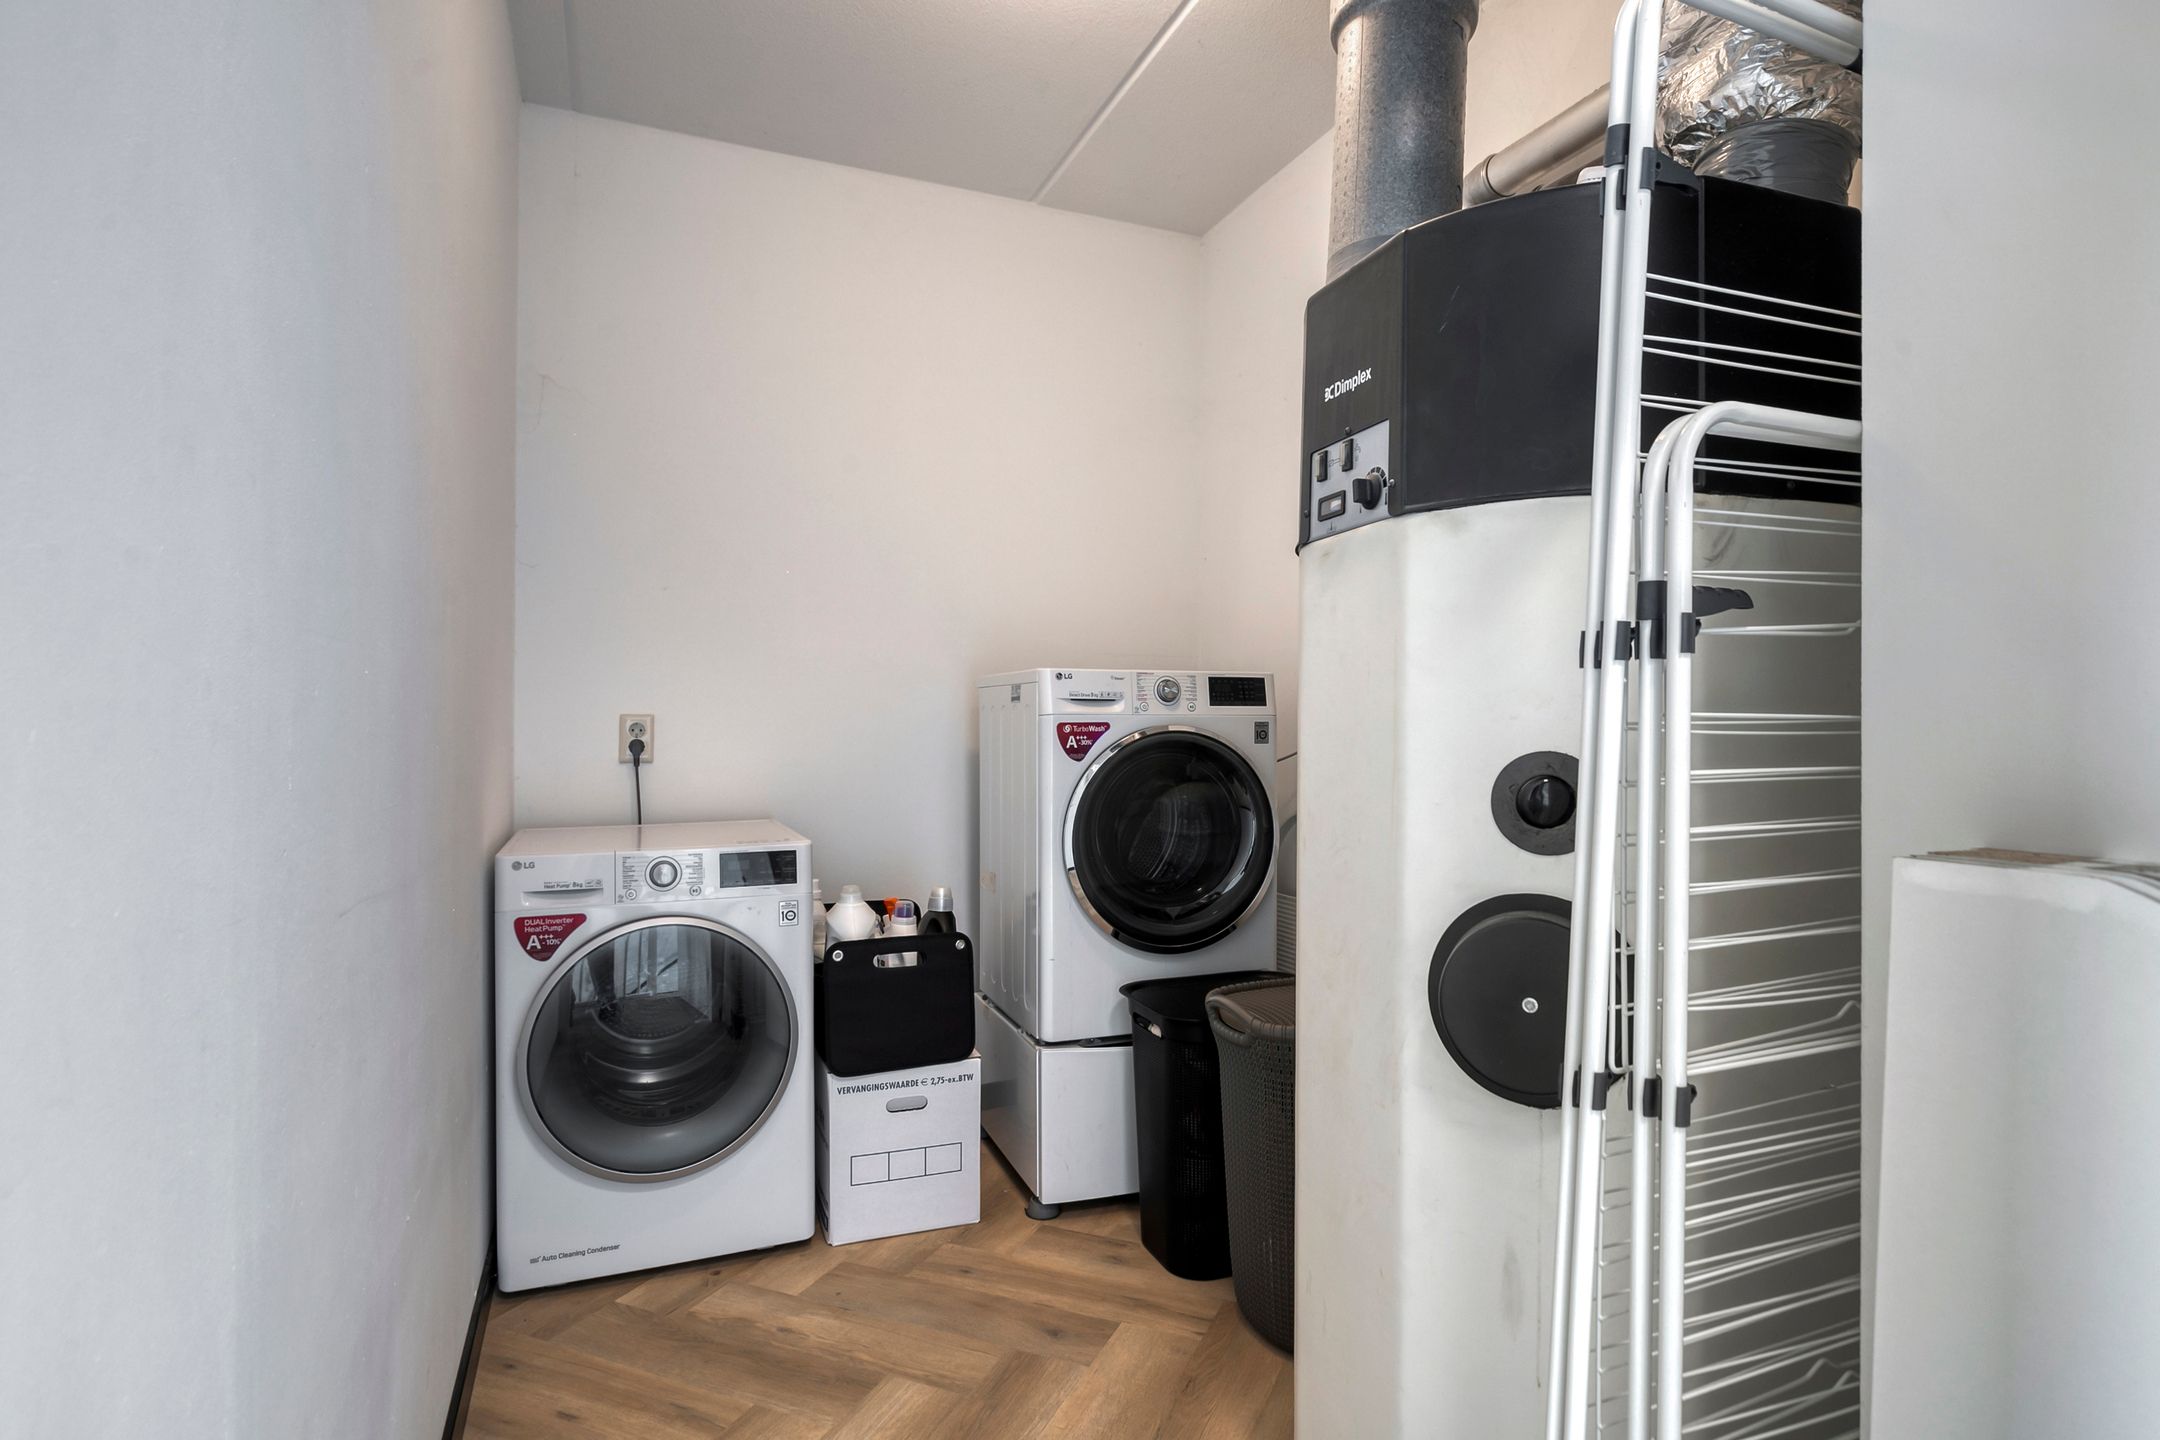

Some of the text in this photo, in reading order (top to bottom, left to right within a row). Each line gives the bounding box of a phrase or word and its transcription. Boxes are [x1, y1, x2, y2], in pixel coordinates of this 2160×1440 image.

[523, 861, 535, 869] LG
[545, 917, 573, 925] Inverter
[524, 925, 542, 933] Heat
[837, 1079, 919, 1094] VERVANGINGSWAARDE
[920, 1077, 929, 1087] €
[558, 1250, 585, 1259] Cleaning
[587, 1244, 620, 1254] Condenser
